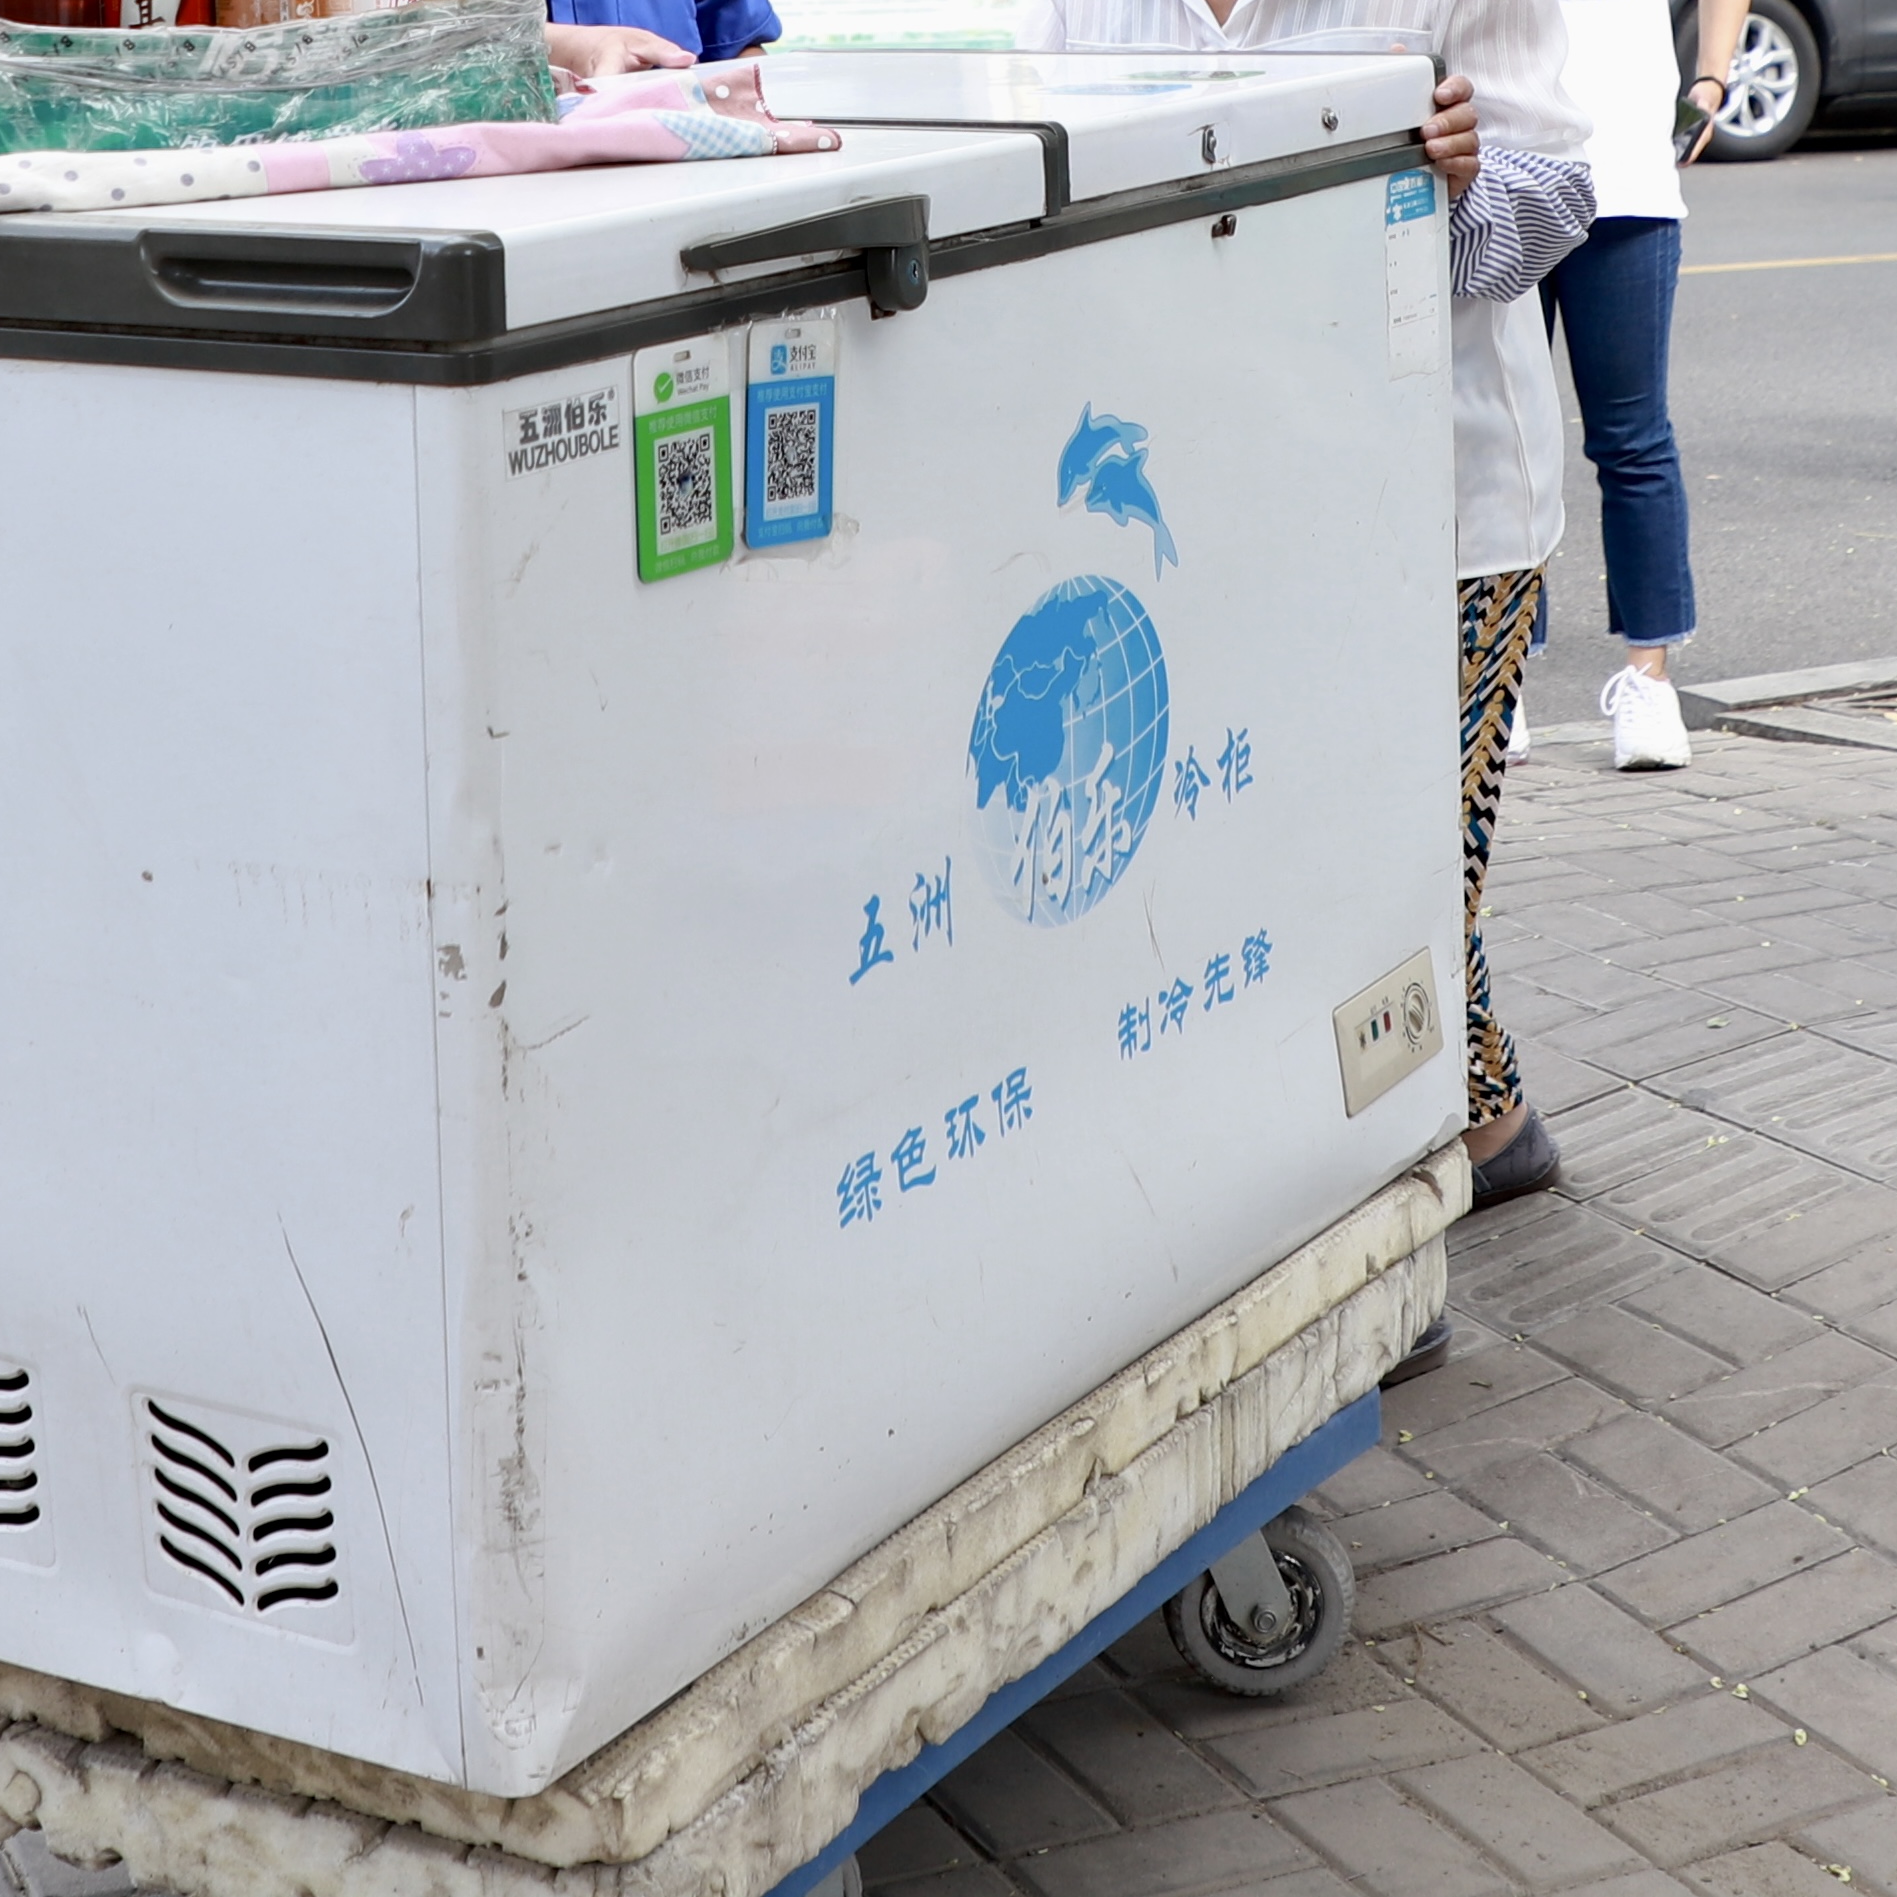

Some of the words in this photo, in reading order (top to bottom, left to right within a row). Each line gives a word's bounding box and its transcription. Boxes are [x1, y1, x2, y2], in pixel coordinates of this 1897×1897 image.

[676, 366, 710, 385] 微信支付
[789, 344, 817, 362] 支付宝
[757, 383, 827, 402] 推荐使用支付宝支付
[518, 395, 607, 445] 五洲伯乐
[648, 406, 718, 434] 推荐使用微信支付
[508, 424, 619, 477] WUZHOUBOLE
[1174, 727, 1253, 821] 冷柜
[1118, 928, 1273, 1060] 制冷先锋
[836, 1066, 1033, 1229] 绿色环保
